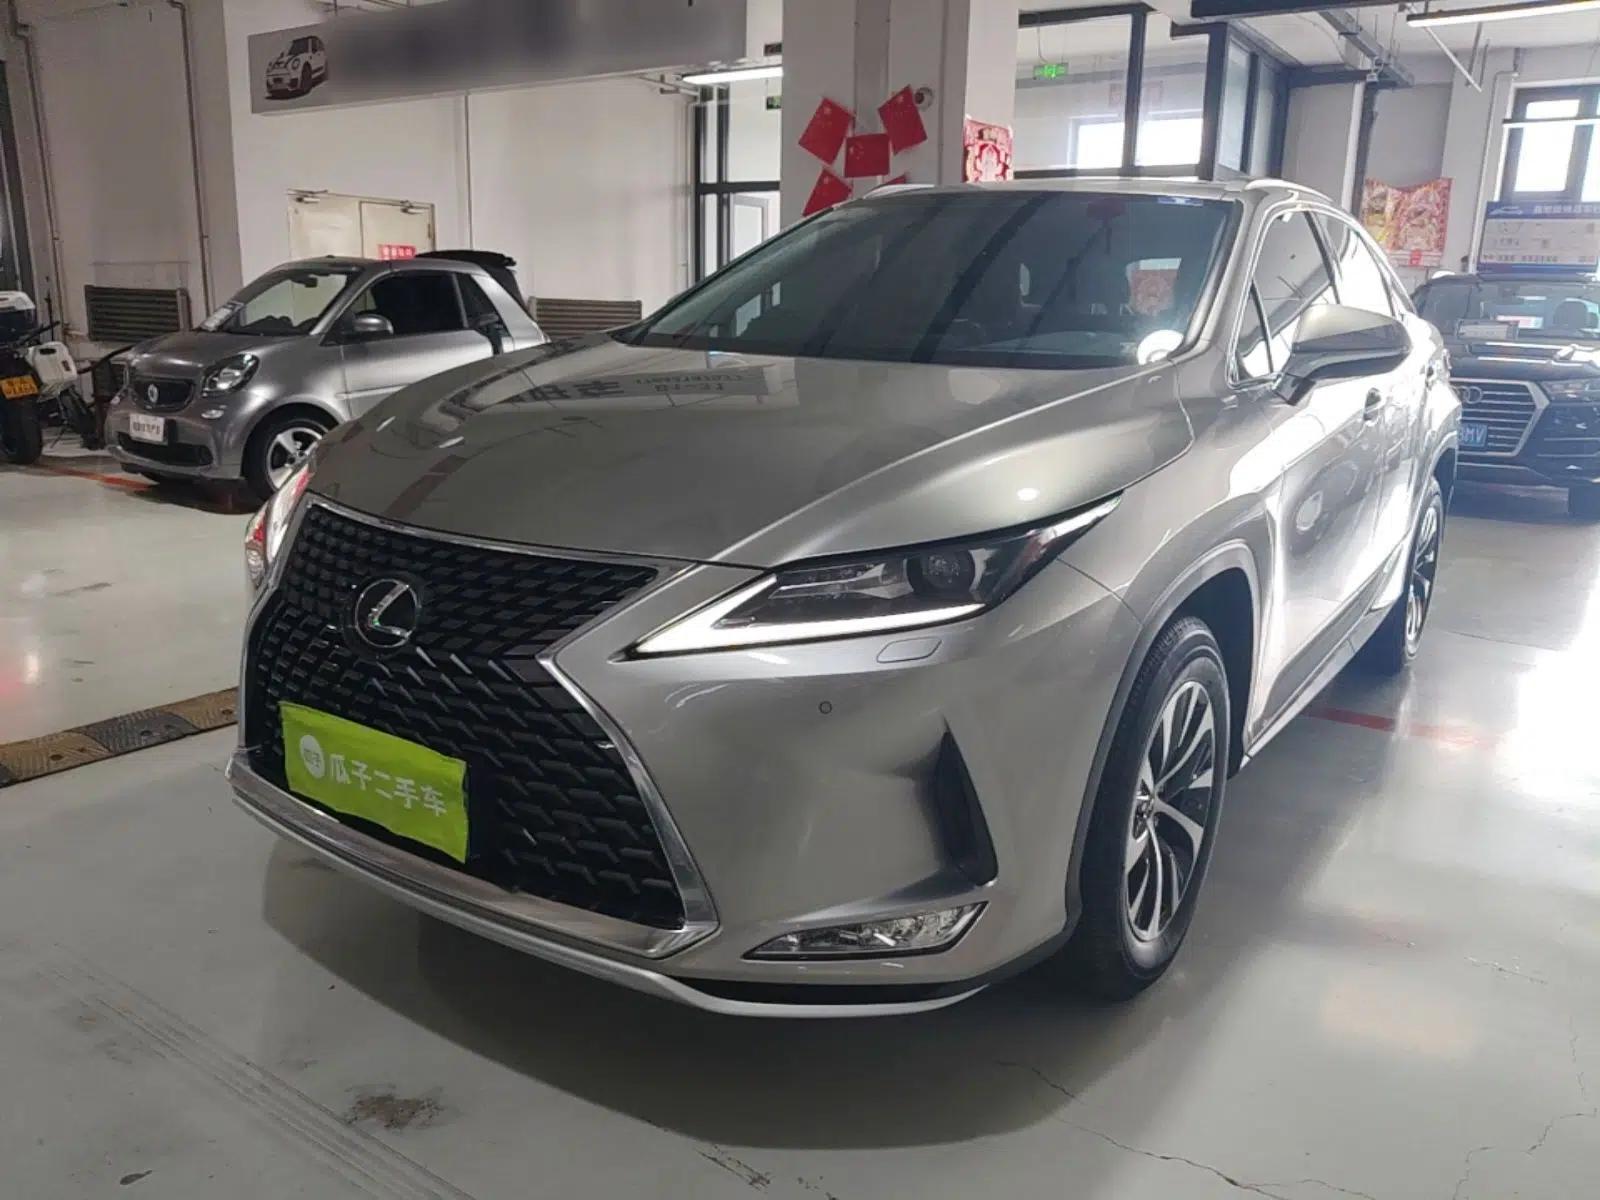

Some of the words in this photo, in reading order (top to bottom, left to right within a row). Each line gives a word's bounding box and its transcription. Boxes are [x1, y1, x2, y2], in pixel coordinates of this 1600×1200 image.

[329, 753, 448, 817] 瓜子二手车
